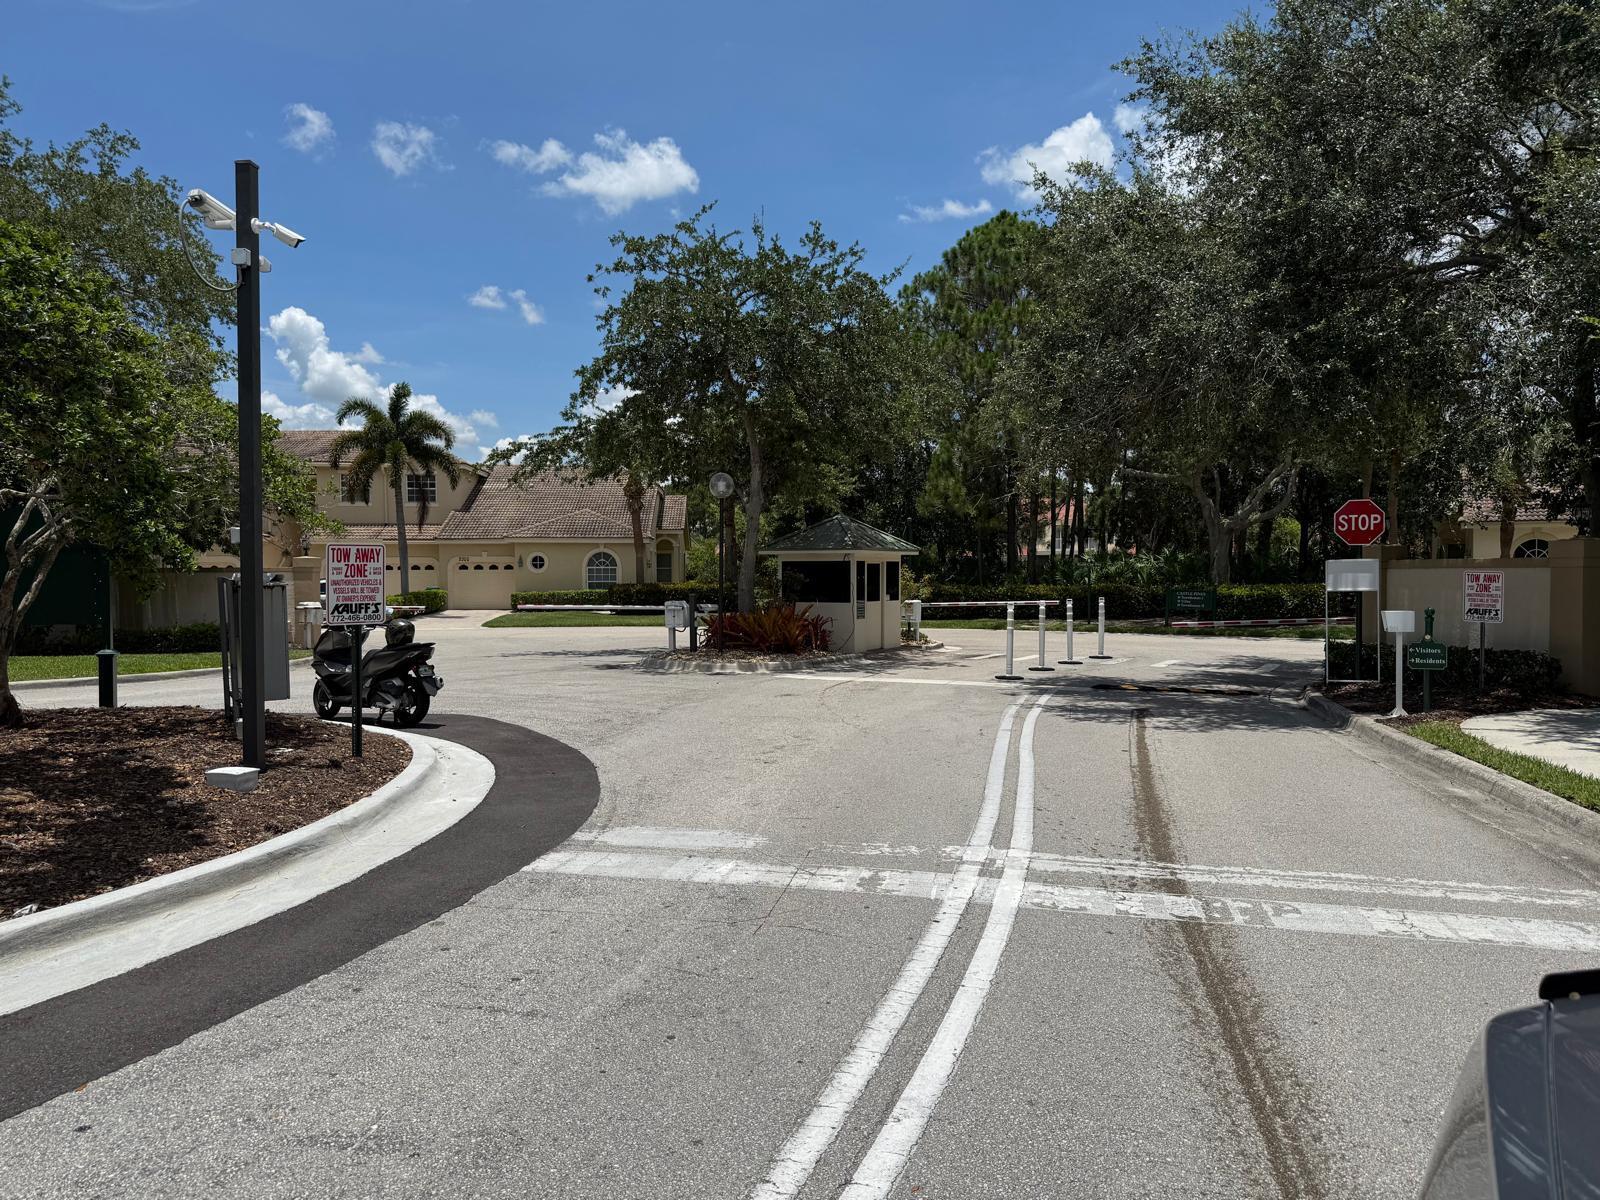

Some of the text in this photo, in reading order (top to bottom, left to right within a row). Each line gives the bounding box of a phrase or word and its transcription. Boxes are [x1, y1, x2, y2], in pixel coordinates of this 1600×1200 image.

[1338, 514, 1381, 531] STOP
[331, 547, 381, 563] TOW AWAY
[344, 563, 368, 578] ZONE
[360, 578, 378, 586] VEHICLES
[1467, 574, 1500, 583] TOW AWAY
[333, 587, 350, 595] VESSELS
[365, 586, 380, 594] TOWED
[1475, 583, 1492, 593] ZONE
[360, 594, 377, 602] EXPENSE
[330, 602, 381, 614] KAUFF'S
[1466, 608, 1500, 616] KAUFF'S
